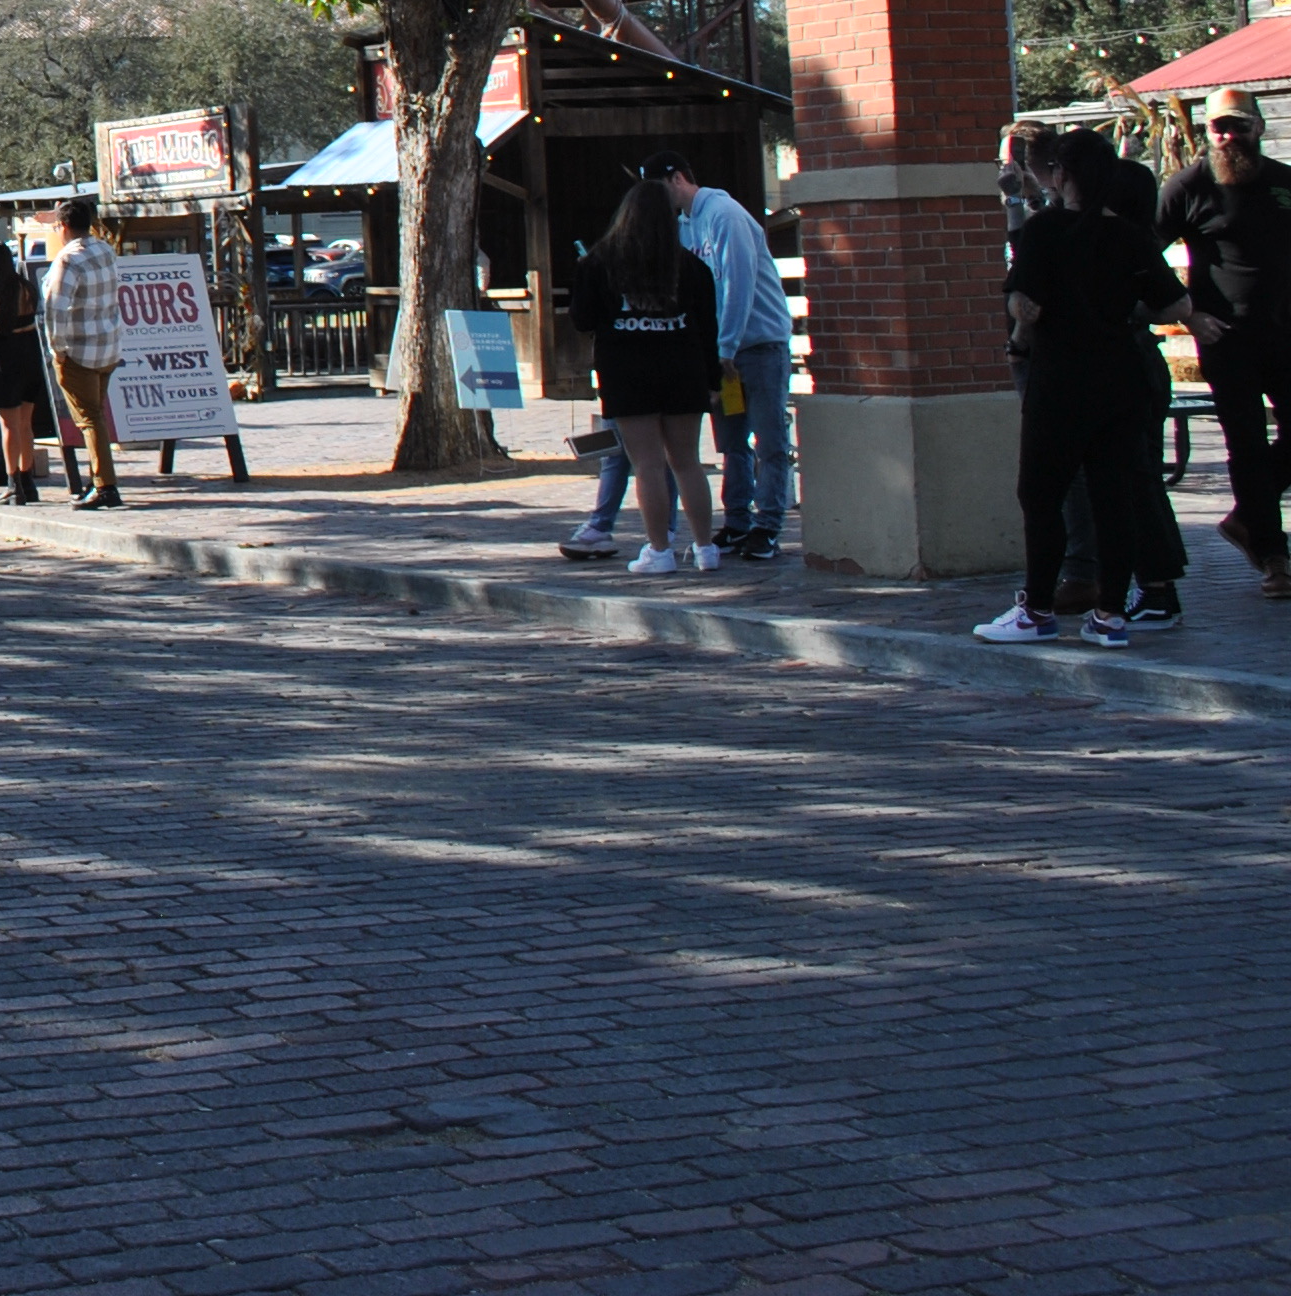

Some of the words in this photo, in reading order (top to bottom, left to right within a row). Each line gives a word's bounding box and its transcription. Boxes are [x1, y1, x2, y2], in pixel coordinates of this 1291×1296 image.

[158, 131, 221, 168] MUSIC
[117, 270, 191, 282] STORIC
[118, 282, 199, 326] OURS
[126, 325, 203, 336] STOCKYARDS
[614, 313, 687, 331] SOCIETY
[145, 350, 209, 371] WEST
[120, 384, 166, 409] FUN
[166, 386, 218, 399] TOURS
